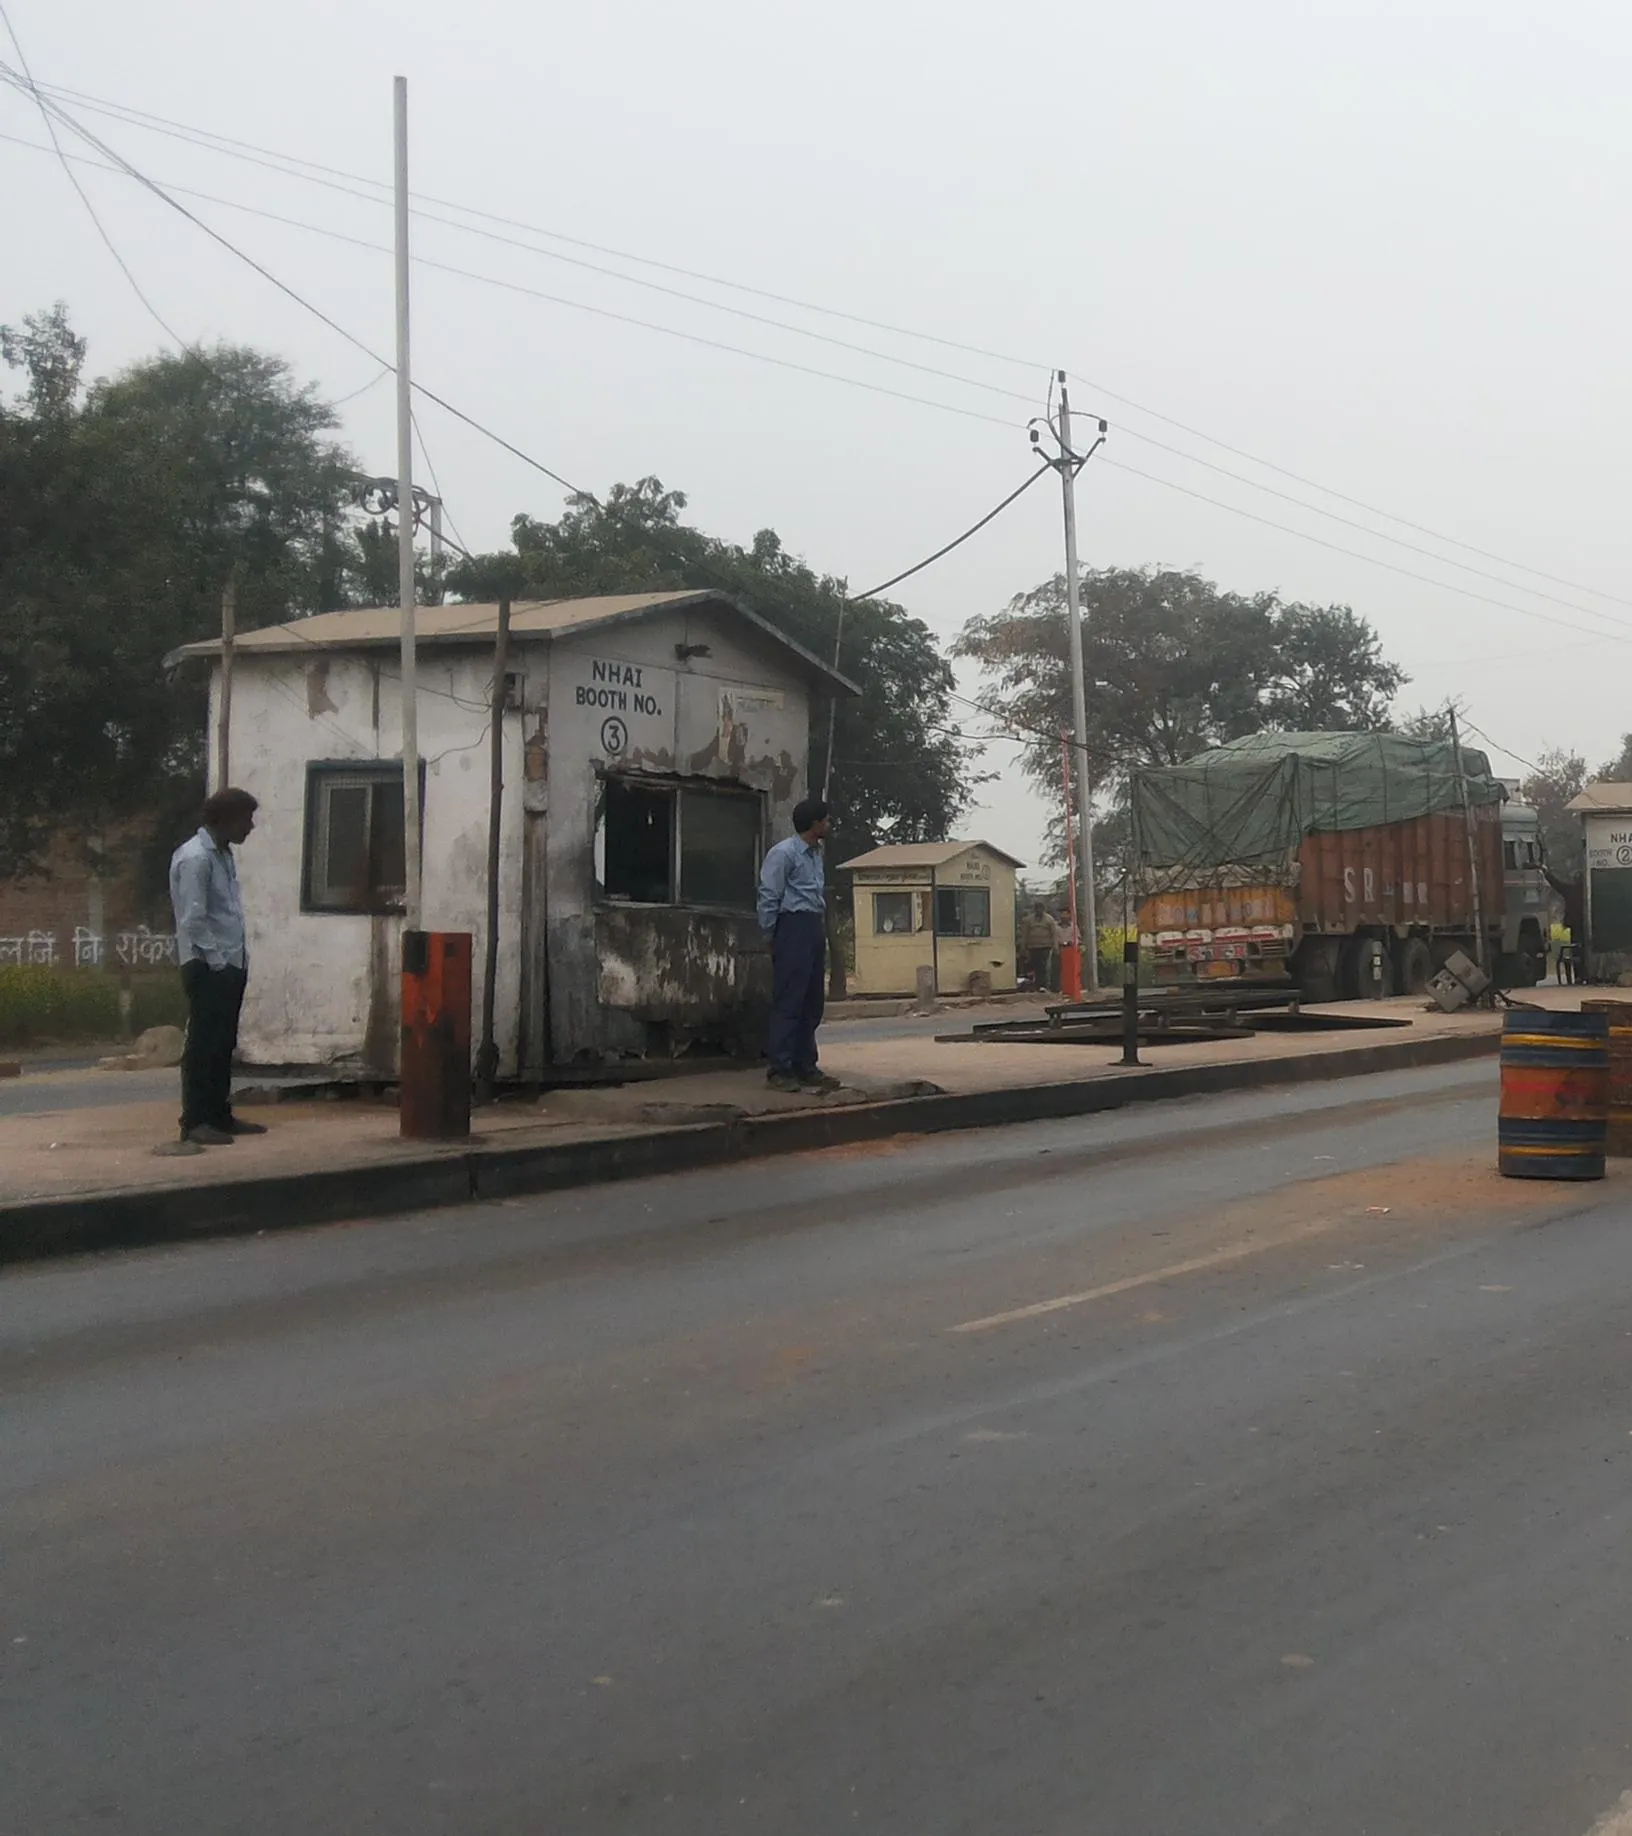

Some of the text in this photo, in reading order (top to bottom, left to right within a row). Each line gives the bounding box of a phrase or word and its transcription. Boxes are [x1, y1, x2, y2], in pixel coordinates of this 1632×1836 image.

[592, 660, 643, 689] NHAI
[575, 686, 662, 716] BOOTH NO.
[607, 724, 621, 751] 3
